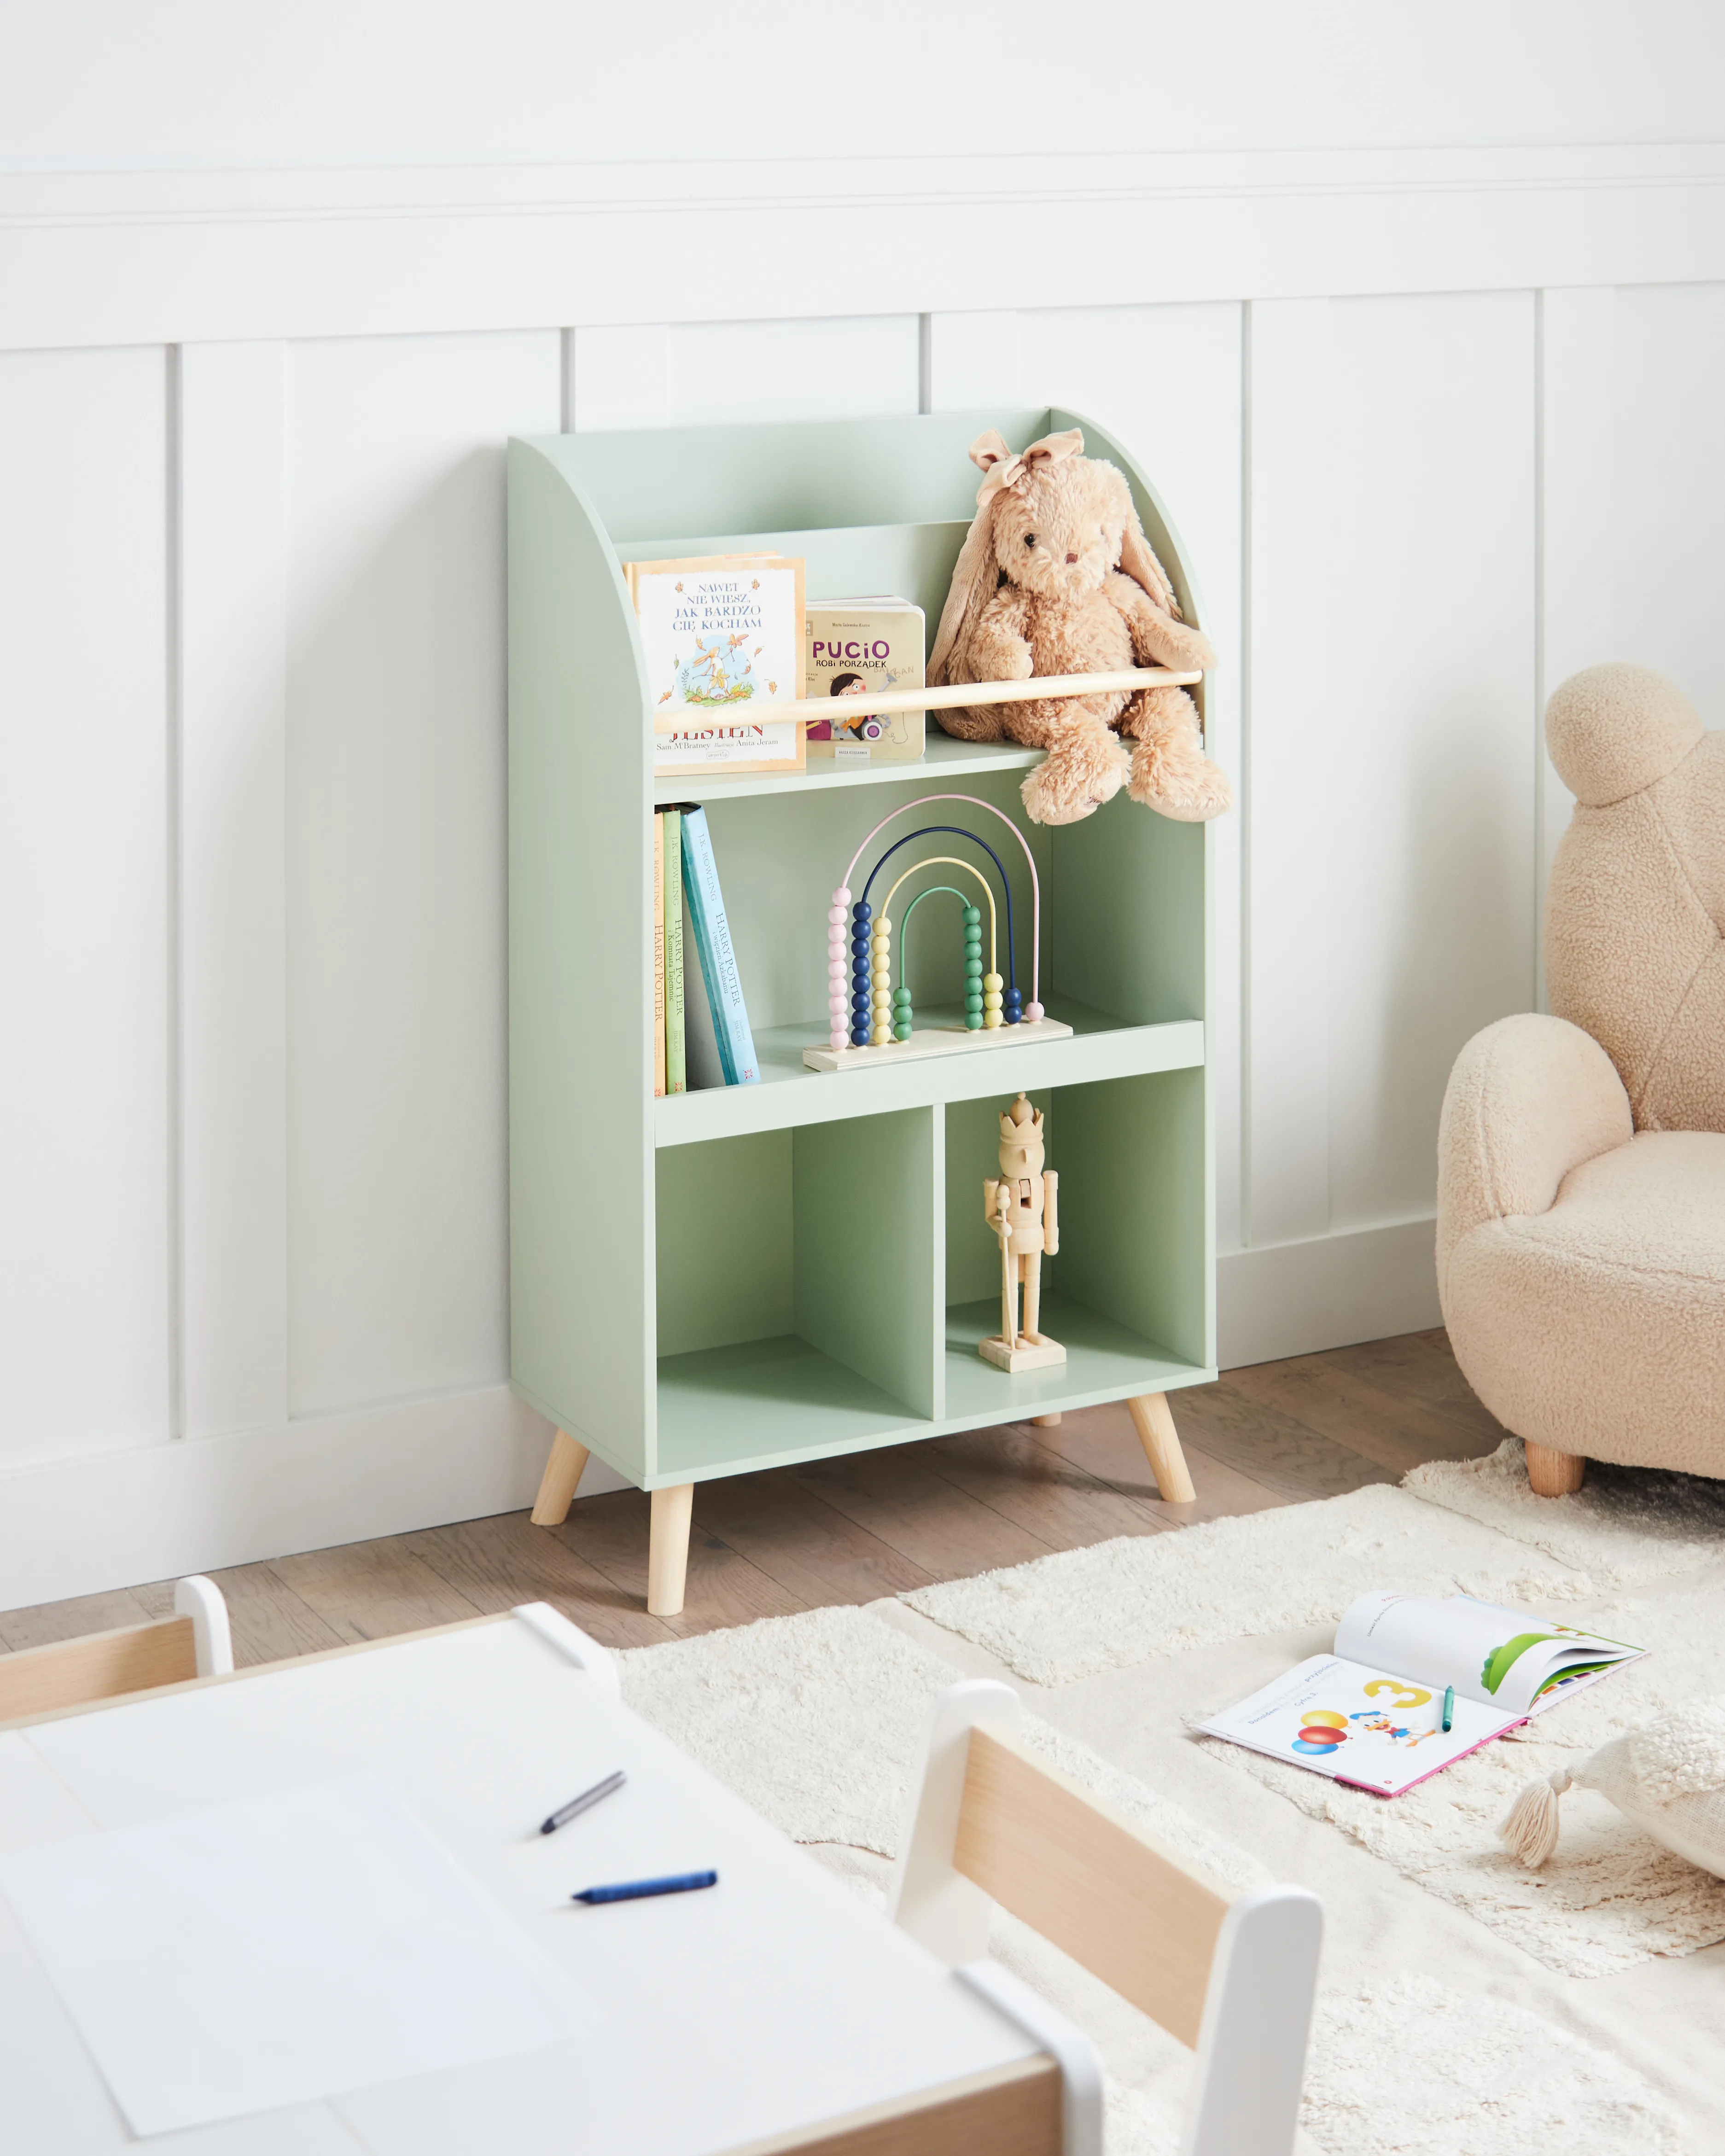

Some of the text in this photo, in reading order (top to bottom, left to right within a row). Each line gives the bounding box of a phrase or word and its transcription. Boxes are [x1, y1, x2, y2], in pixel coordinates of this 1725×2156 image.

[699, 583, 739, 593] NAWET
[687, 594, 751, 604] NIE WIESZ,
[675, 605, 761, 618] JAK BARDZO
[672, 618, 762, 632] CIĘ KOCHAM
[839, 660, 886, 669] PORZĄDEK
[702, 852, 717, 901] ROWLING
[716, 912, 740, 1007] HARRY POTTER
[655, 925, 663, 1022] HARRY POTTER
[718, 961, 728, 994] Azkabanu
[1364, 1679, 1432, 1708] 3
